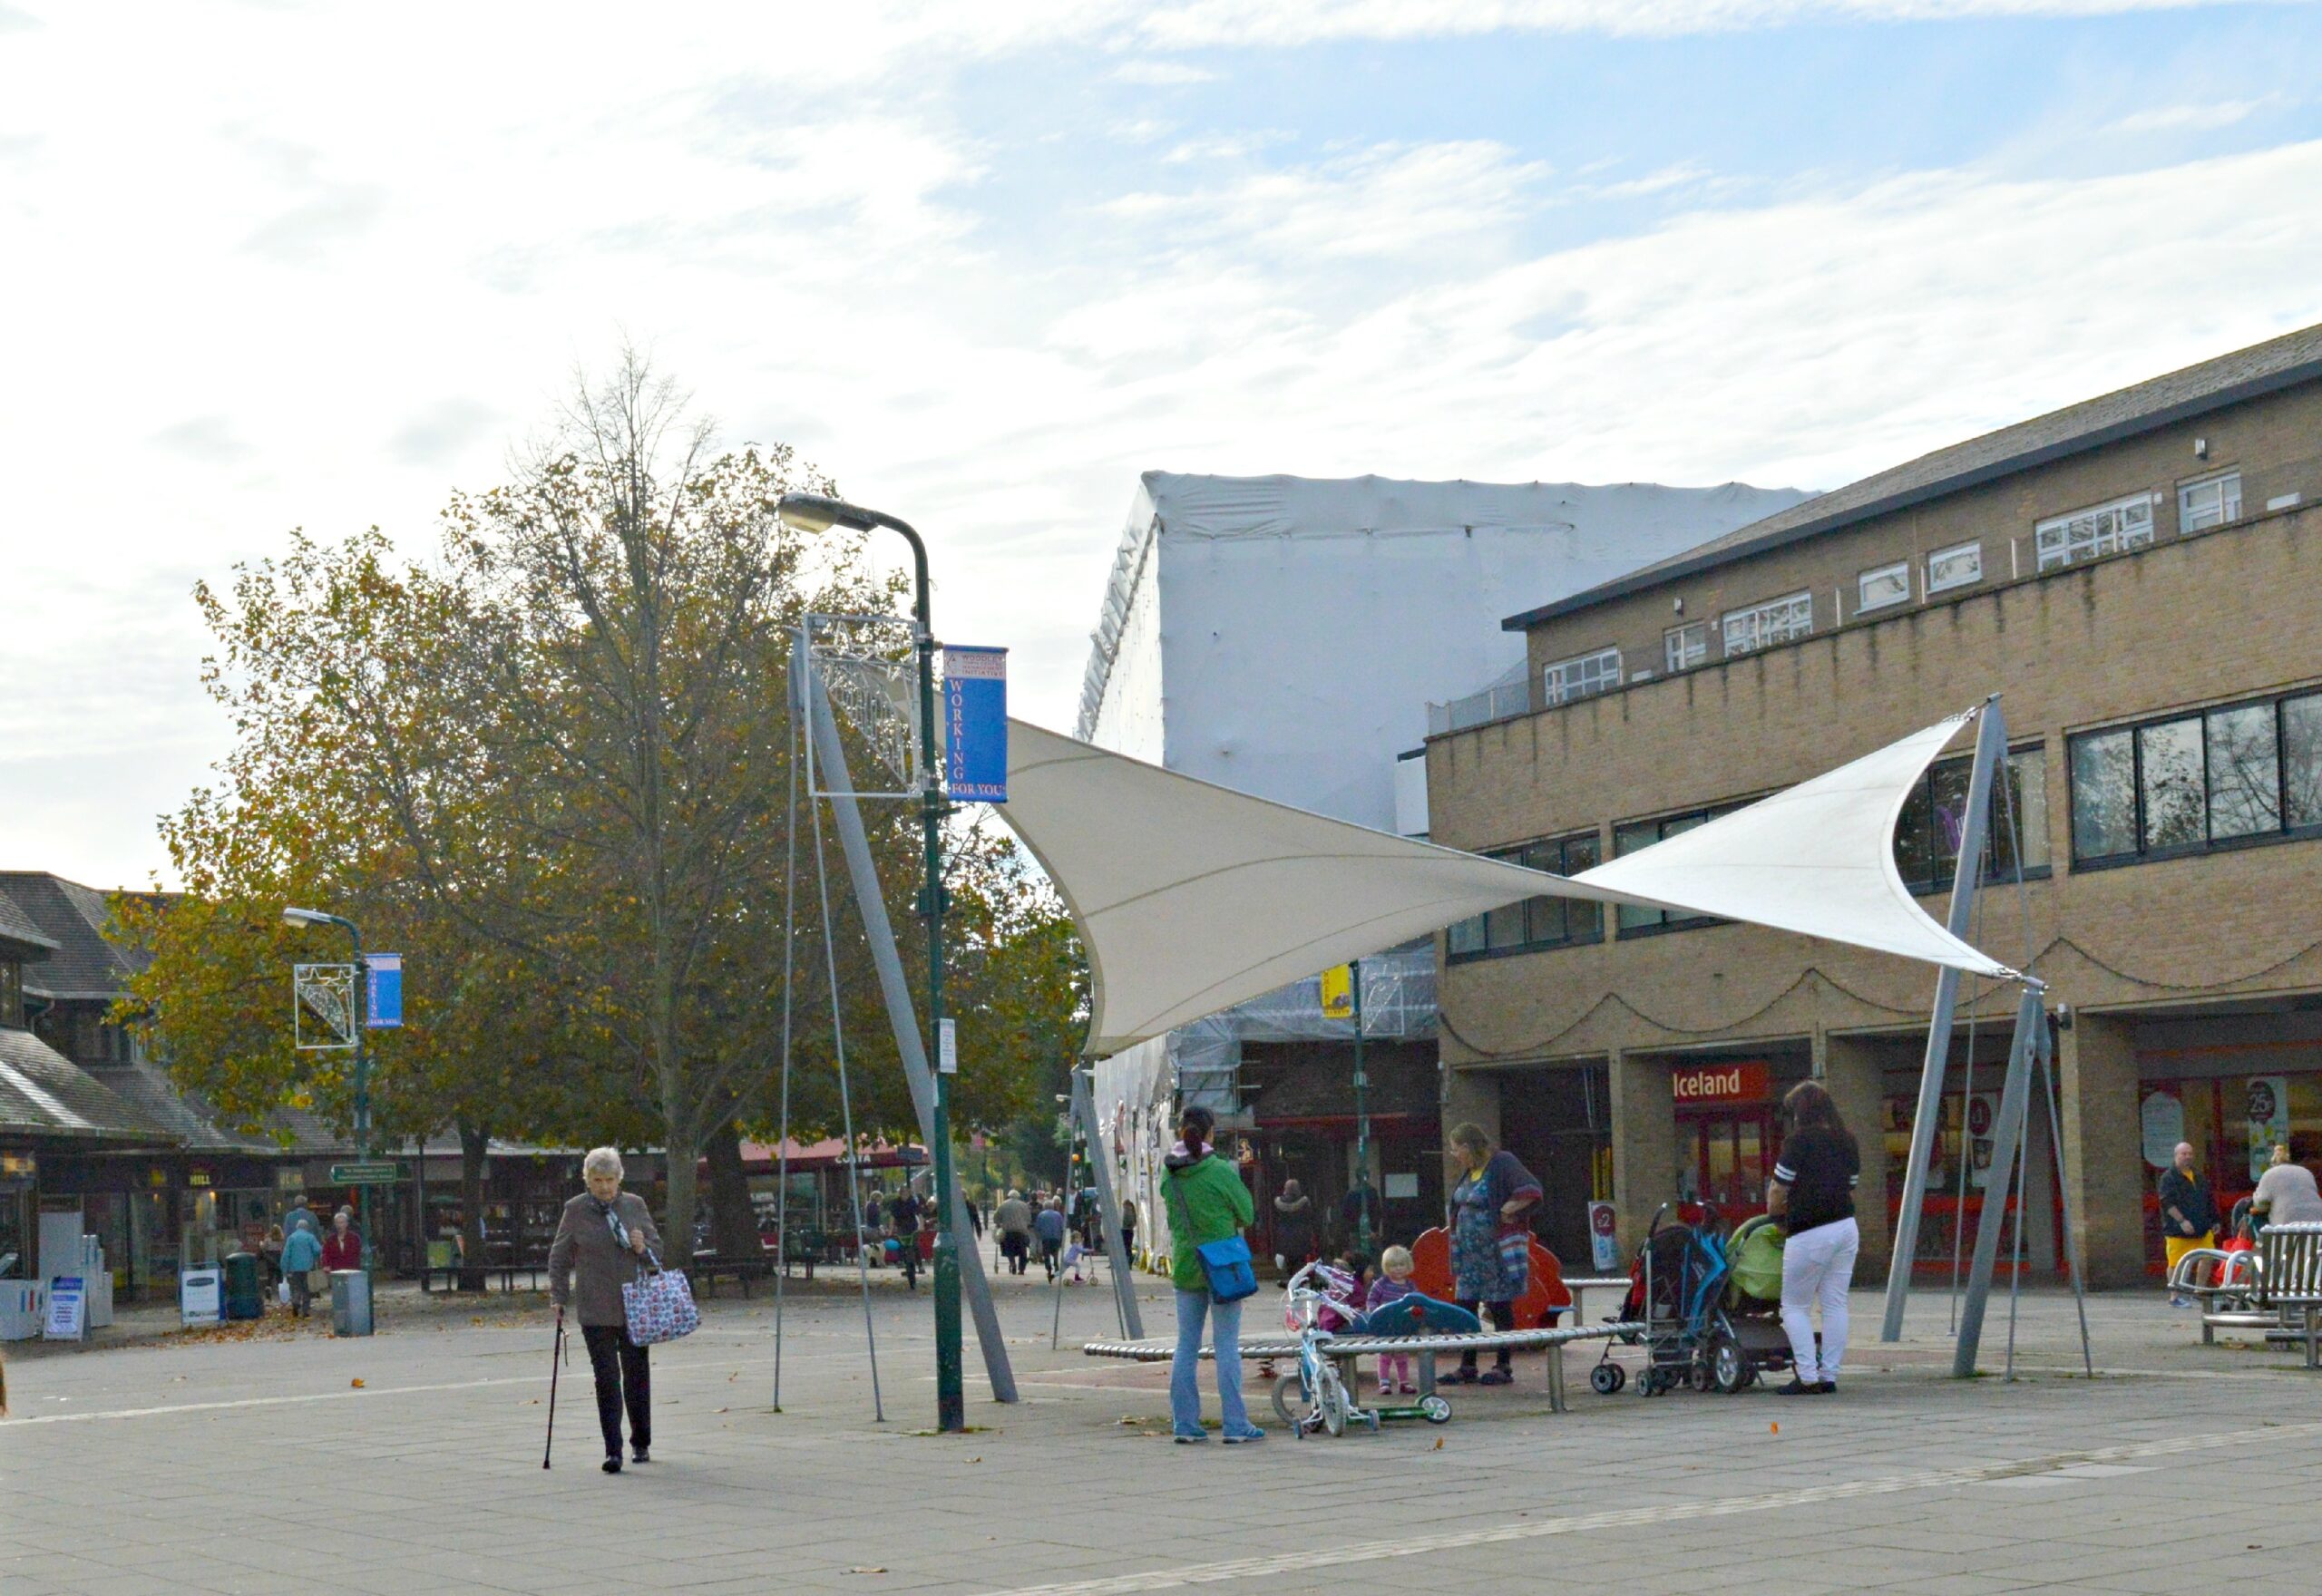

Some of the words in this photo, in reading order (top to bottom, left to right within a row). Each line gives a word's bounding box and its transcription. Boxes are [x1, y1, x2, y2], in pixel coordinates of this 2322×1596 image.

[961, 654, 1002, 662] WOODLEY
[950, 679, 963, 780] WORKING
[951, 783, 975, 794] FOR
[978, 783, 1002, 795] YOU
[1673, 1069, 1741, 1097] Iceland
